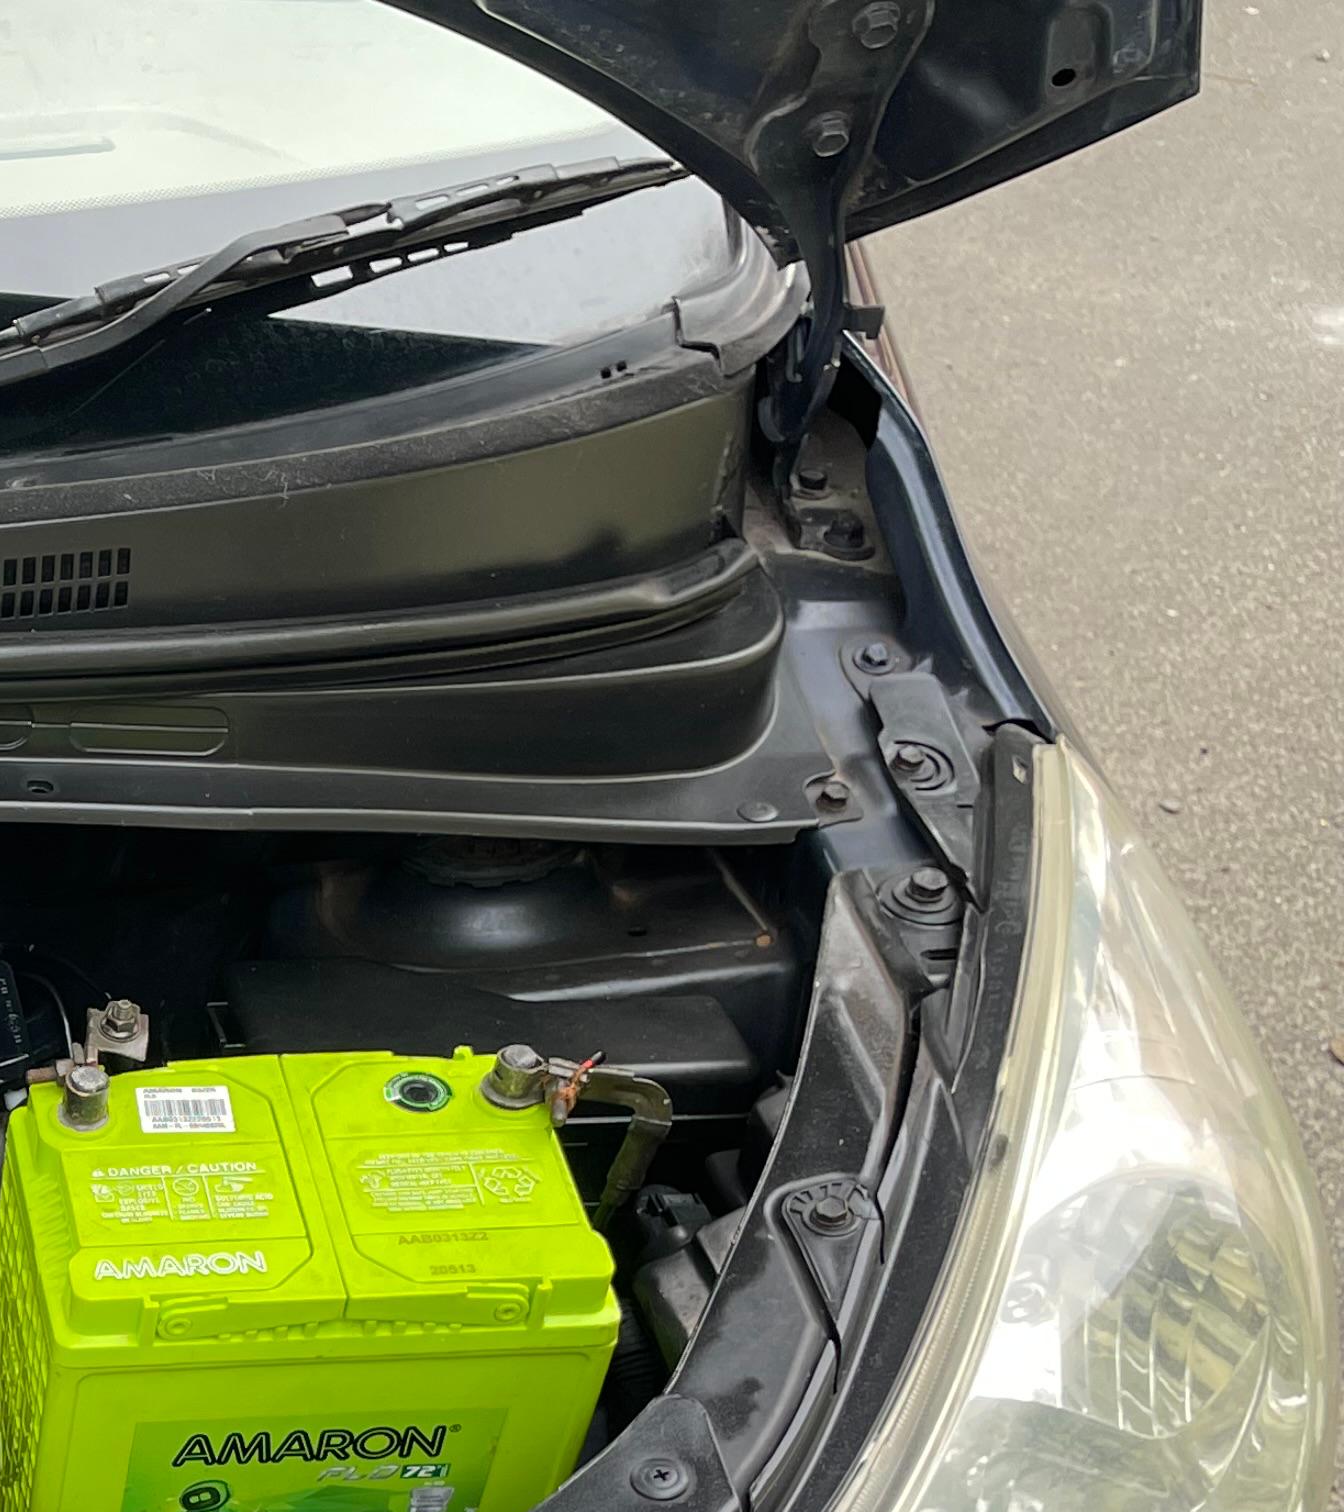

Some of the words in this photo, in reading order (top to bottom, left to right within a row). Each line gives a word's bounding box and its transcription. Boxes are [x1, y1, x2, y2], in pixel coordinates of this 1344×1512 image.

[108, 1165, 172, 1177] DANGER
[186, 1162, 257, 1174] CAUTION
[95, 1250, 268, 1280] AMARON
[172, 1424, 448, 1467] AMARON
